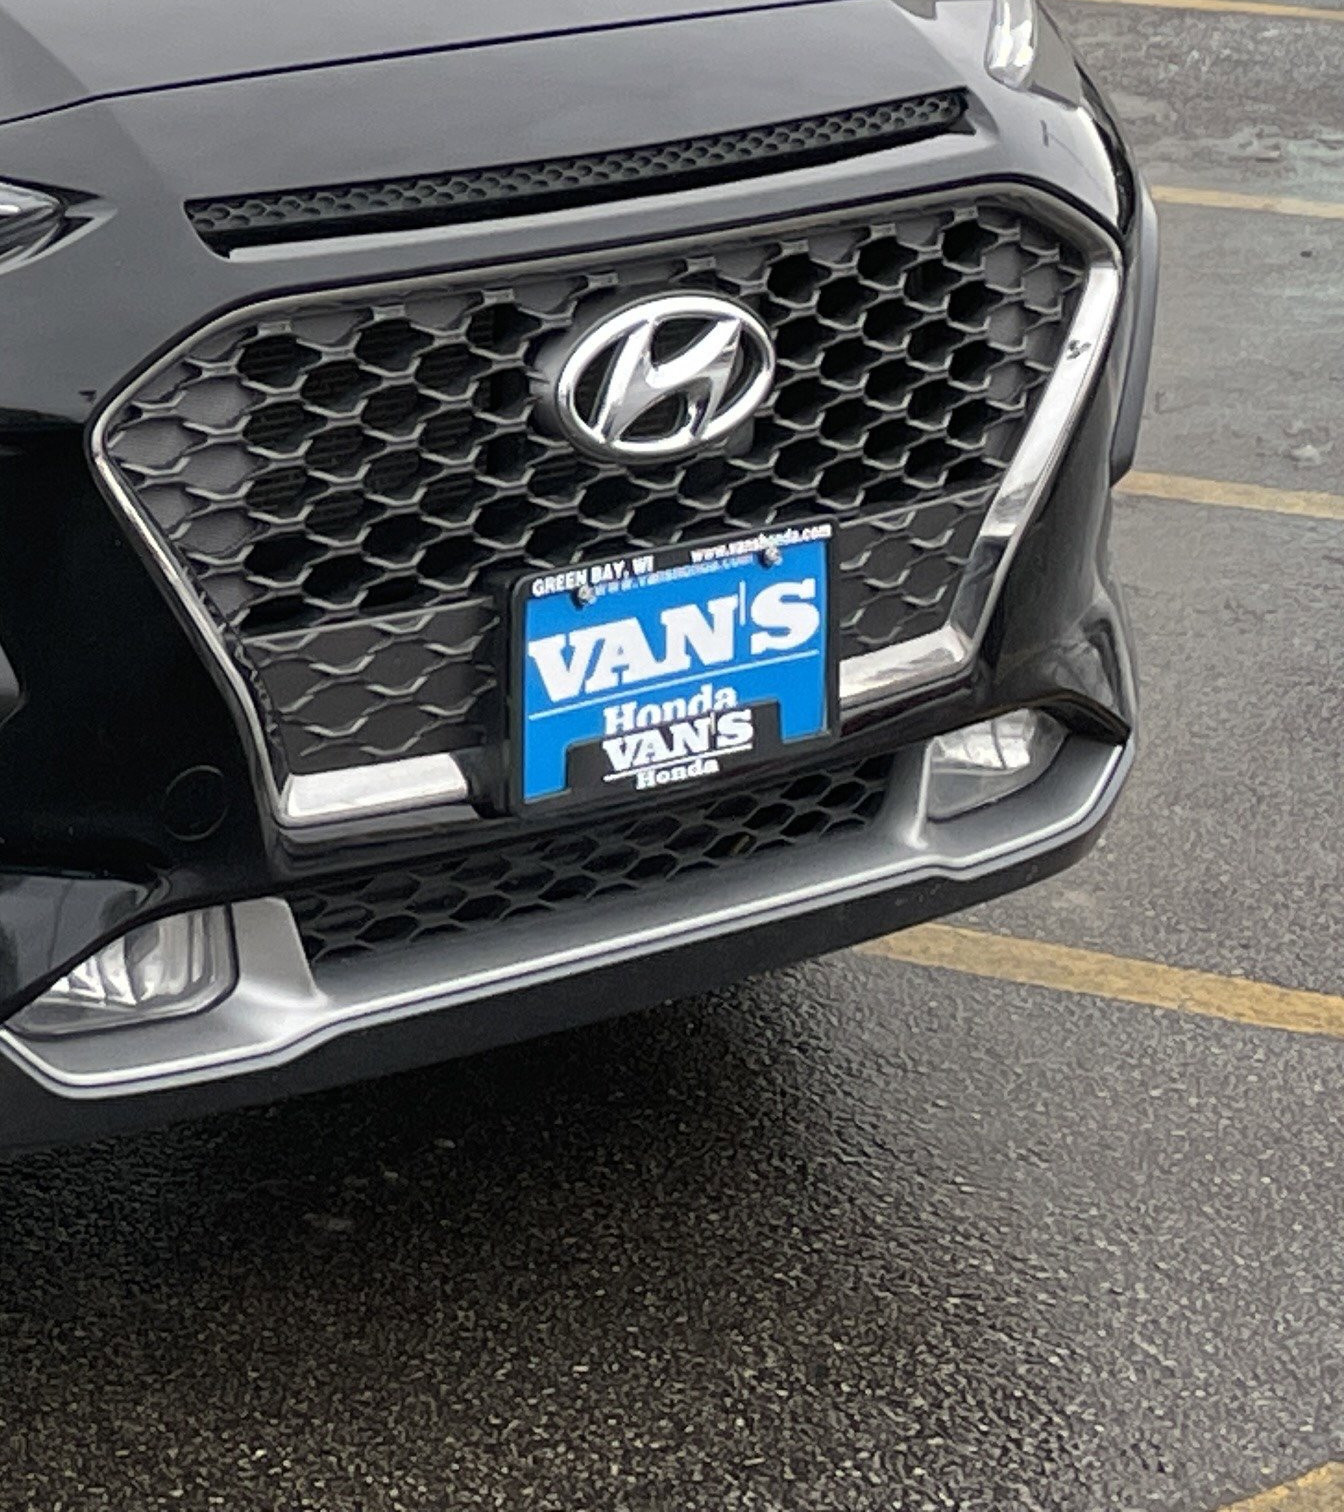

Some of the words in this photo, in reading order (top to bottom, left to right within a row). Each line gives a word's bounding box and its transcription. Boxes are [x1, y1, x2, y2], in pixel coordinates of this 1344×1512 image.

[531, 568, 589, 598] GREEN
[527, 577, 821, 702] VAN'S
[602, 683, 738, 736] Honda
[601, 708, 754, 772] VAN'S
[635, 757, 720, 790] Honda
